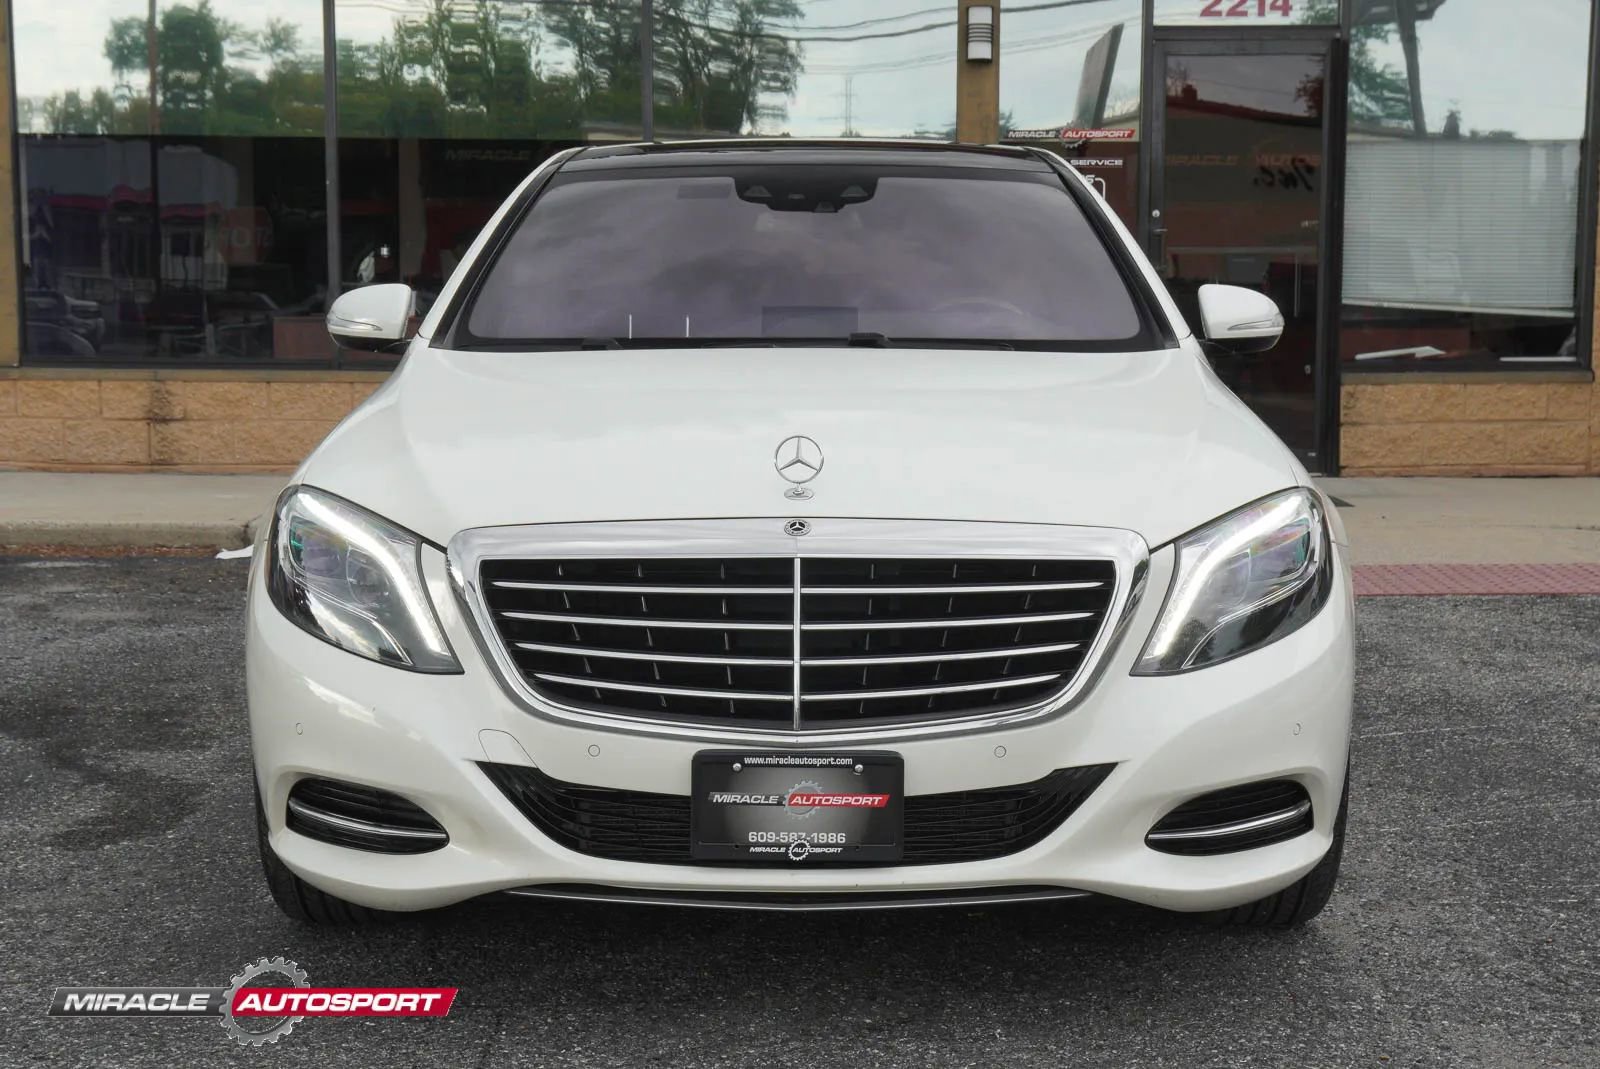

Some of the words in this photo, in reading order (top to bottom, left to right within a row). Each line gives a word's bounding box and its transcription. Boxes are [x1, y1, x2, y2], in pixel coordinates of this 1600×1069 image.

[1200, 0, 1293, 17] 2214
[1008, 130, 1056, 138] MIRACLE
[1064, 130, 1132, 138] AUTOSPORT
[744, 756, 853, 767] www.miracleautosport.com
[712, 794, 779, 804] MIRACLE
[790, 796, 883, 806] AUTOSPORT
[748, 831, 846, 844] 609-587-1986
[749, 846, 786, 854] MIRACLE
[792, 846, 843, 854] AUTOSPORT
